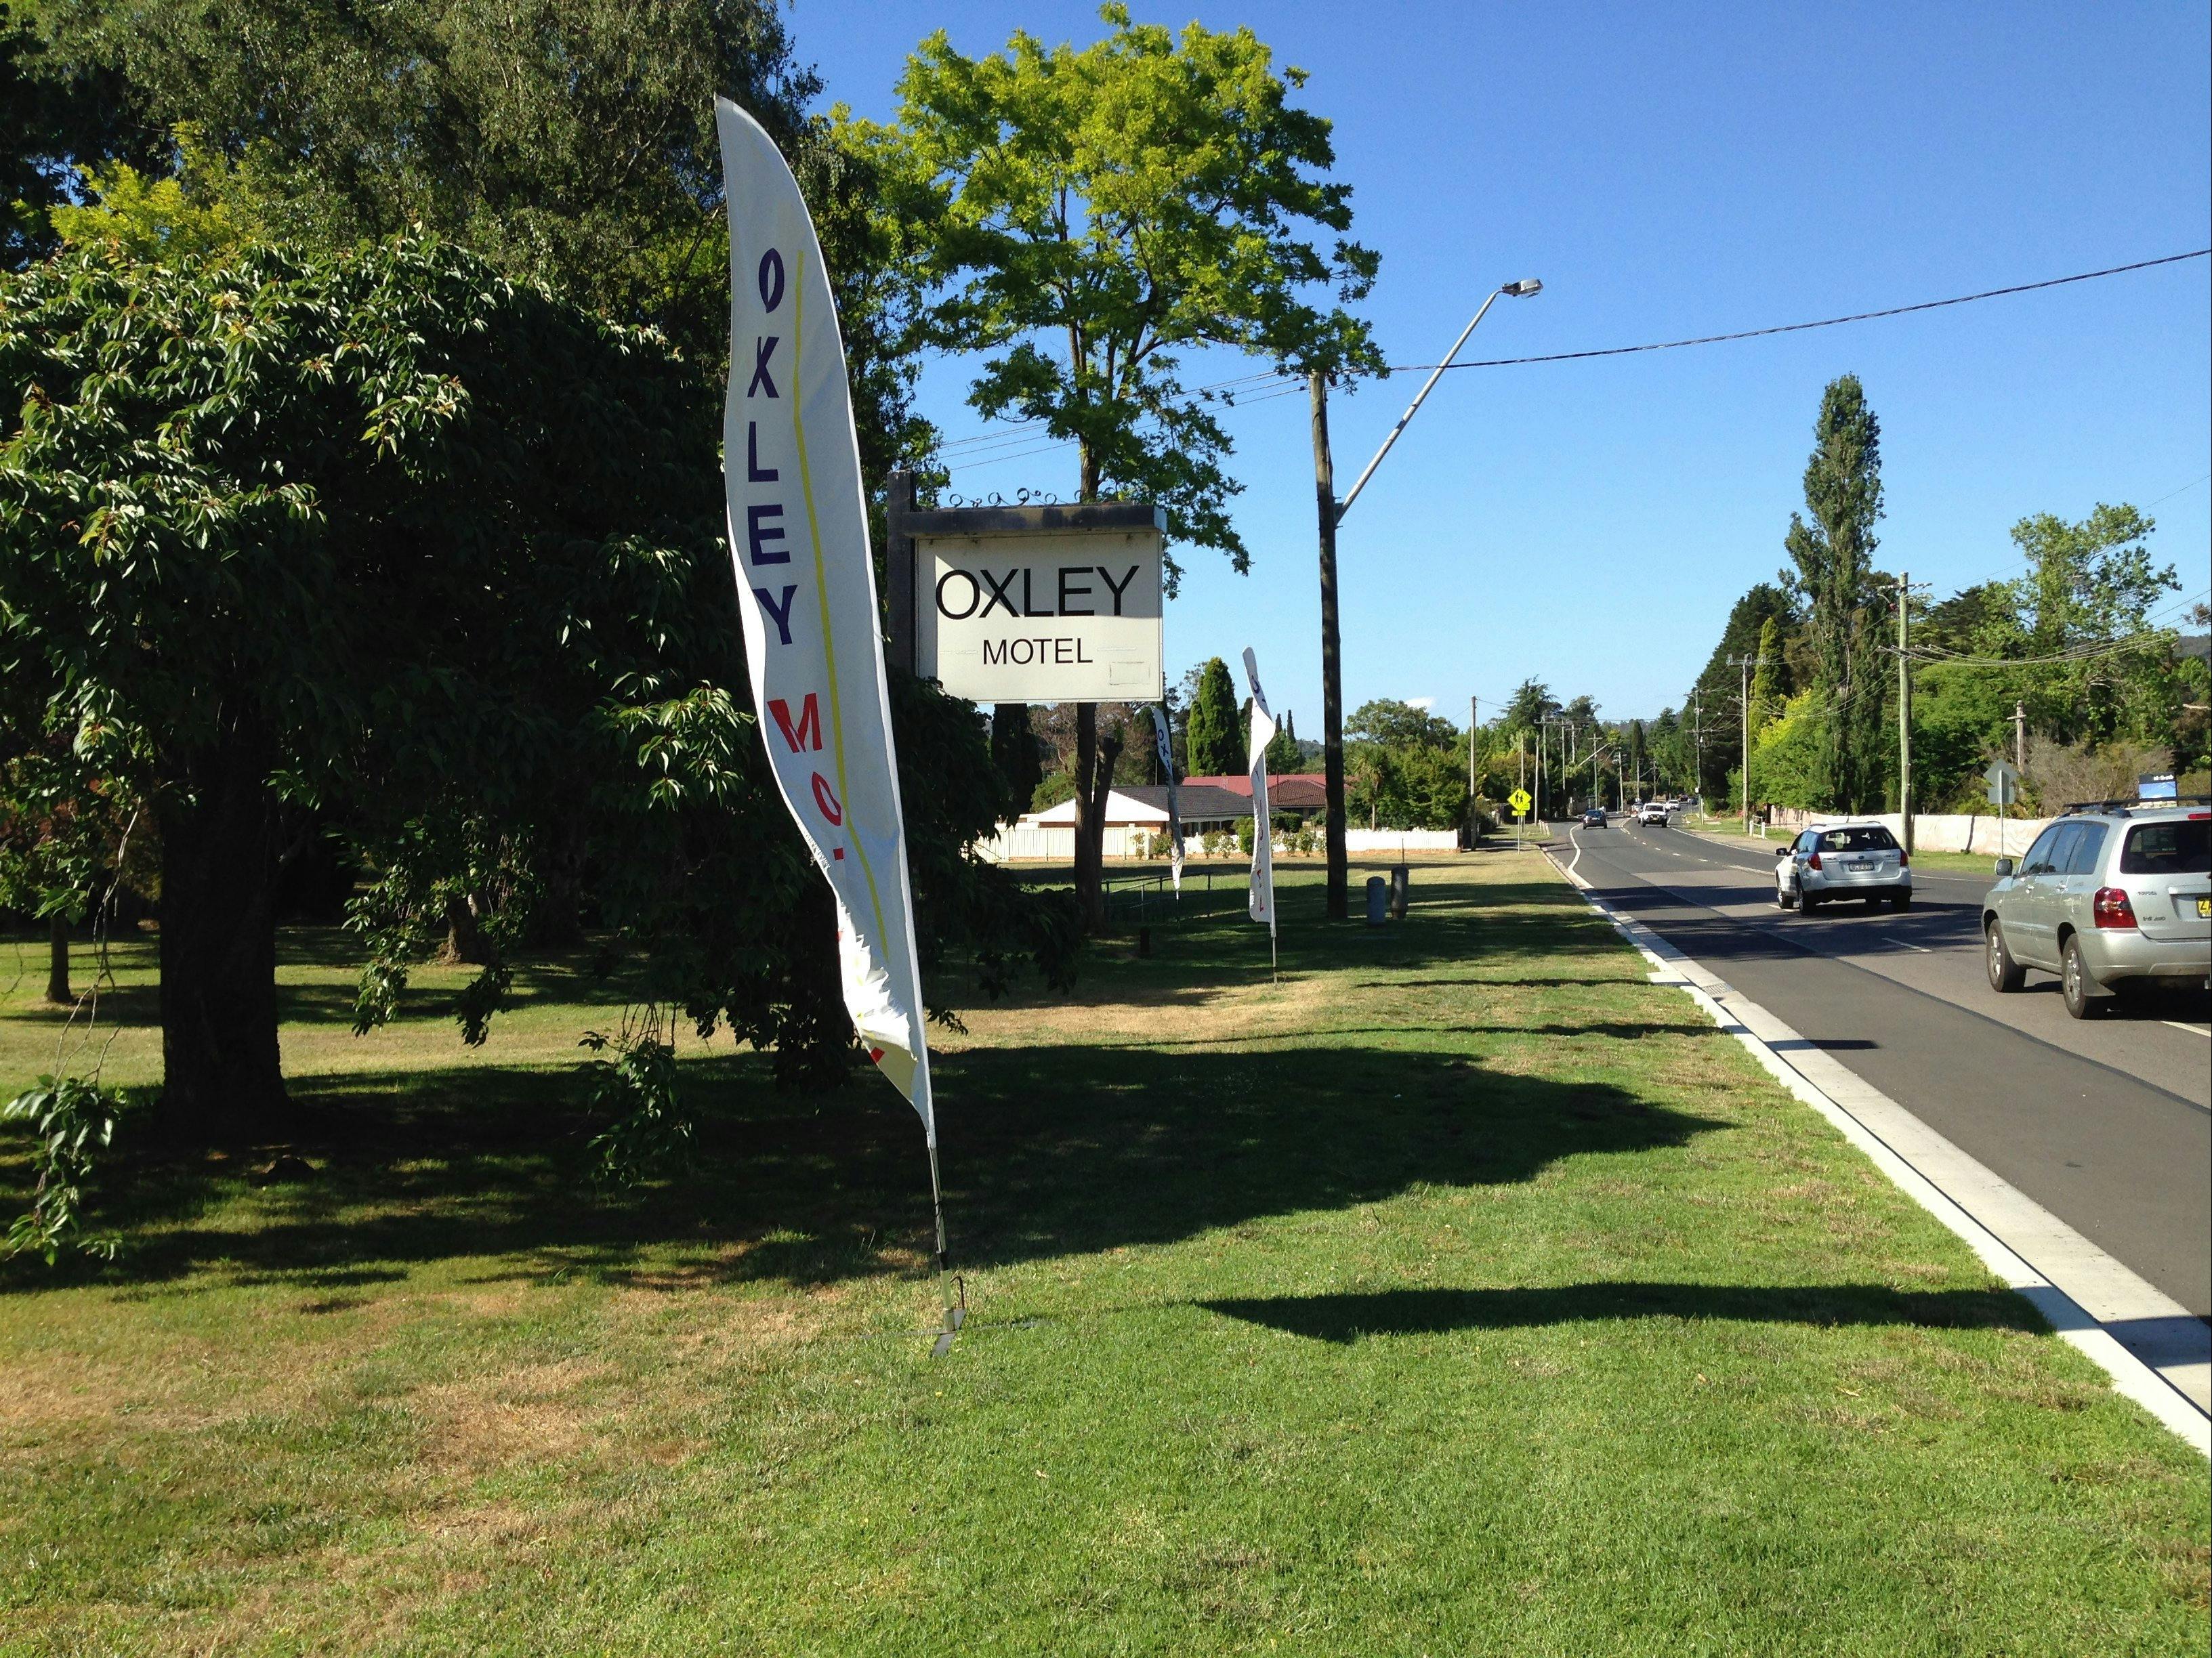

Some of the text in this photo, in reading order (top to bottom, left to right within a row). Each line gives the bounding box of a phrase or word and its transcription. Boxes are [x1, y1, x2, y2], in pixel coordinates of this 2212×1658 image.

[747, 247, 798, 645] OXLEY
[935, 565, 1140, 620] OXLEY
[982, 637, 1093, 665] MOTEL
